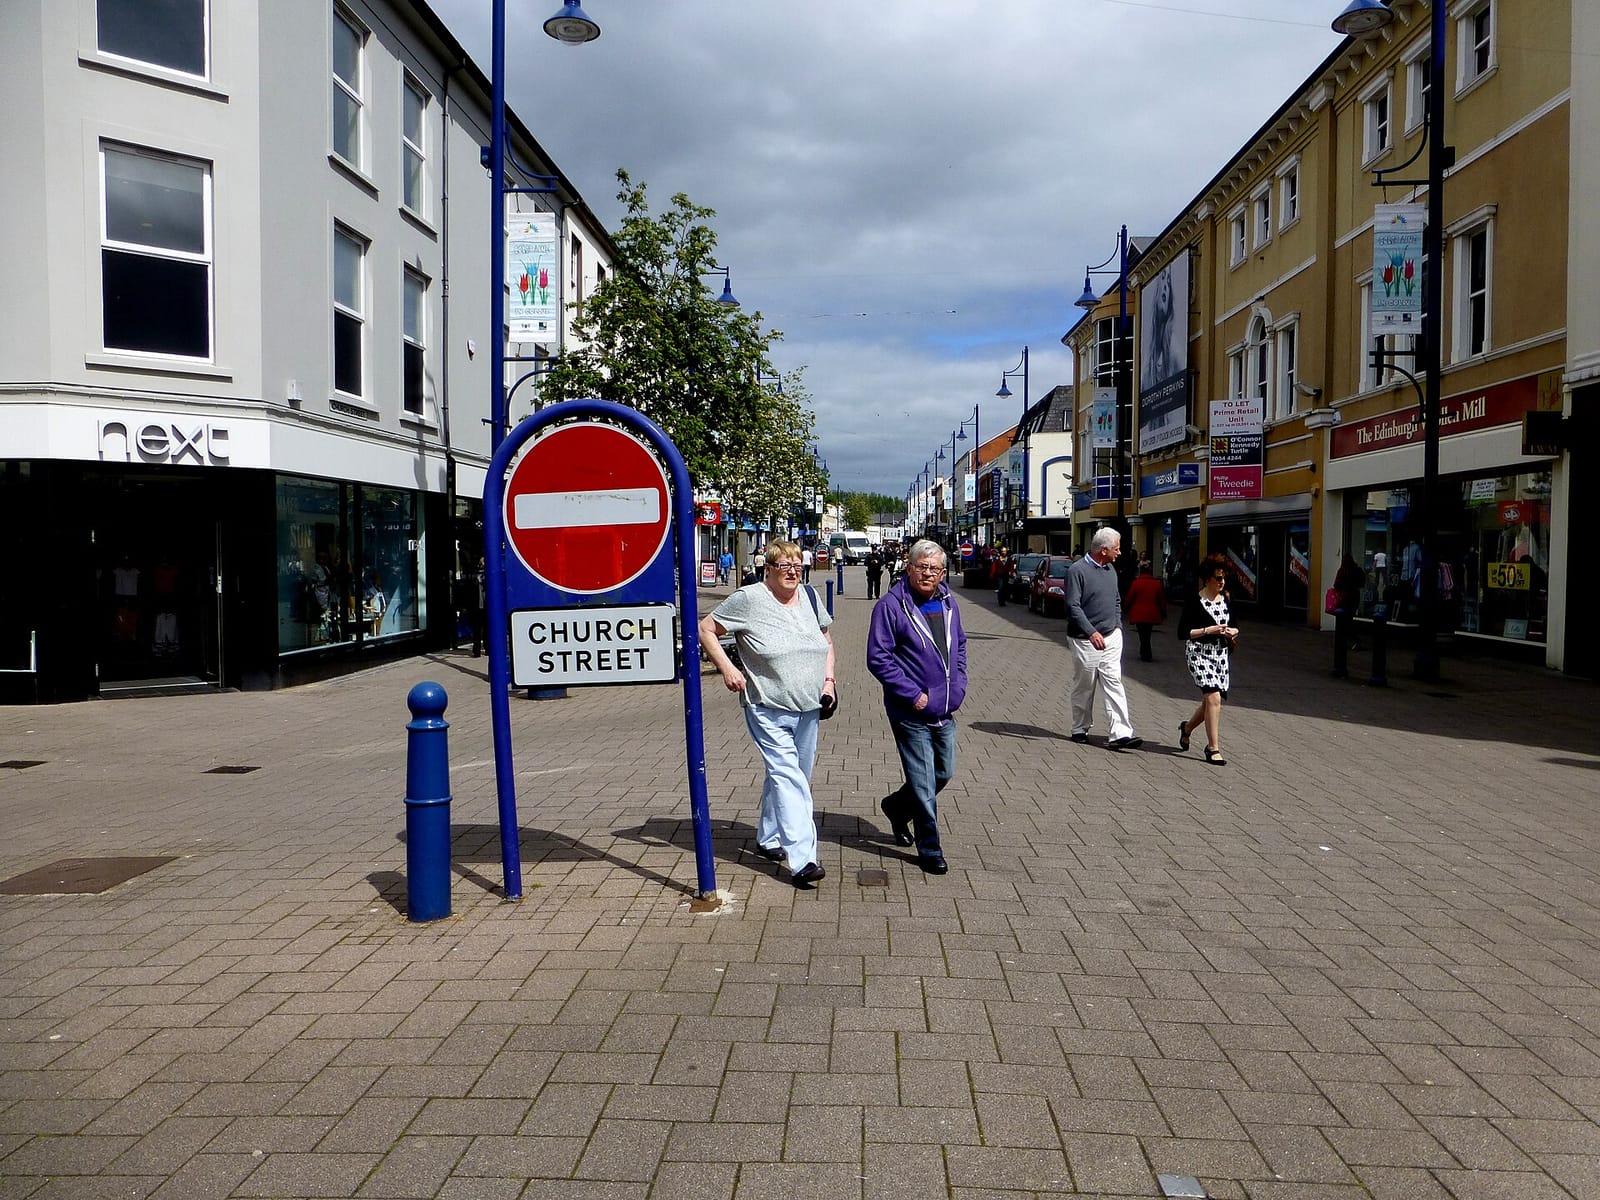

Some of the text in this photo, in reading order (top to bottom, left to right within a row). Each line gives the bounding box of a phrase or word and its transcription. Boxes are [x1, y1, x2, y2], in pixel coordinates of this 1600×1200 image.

[1142, 391, 1162, 408] DOROTHY
[1163, 378, 1185, 396] PERKINS
[1357, 427, 1372, 445] The
[1374, 414, 1418, 440] Edinburgh
[1462, 396, 1486, 420] Mill
[98, 418, 230, 464] next
[1218, 480, 1254, 488] Tweedie
[1497, 564, 1516, 587] 50
[528, 618, 657, 645] CHURCH
[538, 647, 650, 673] STREET
